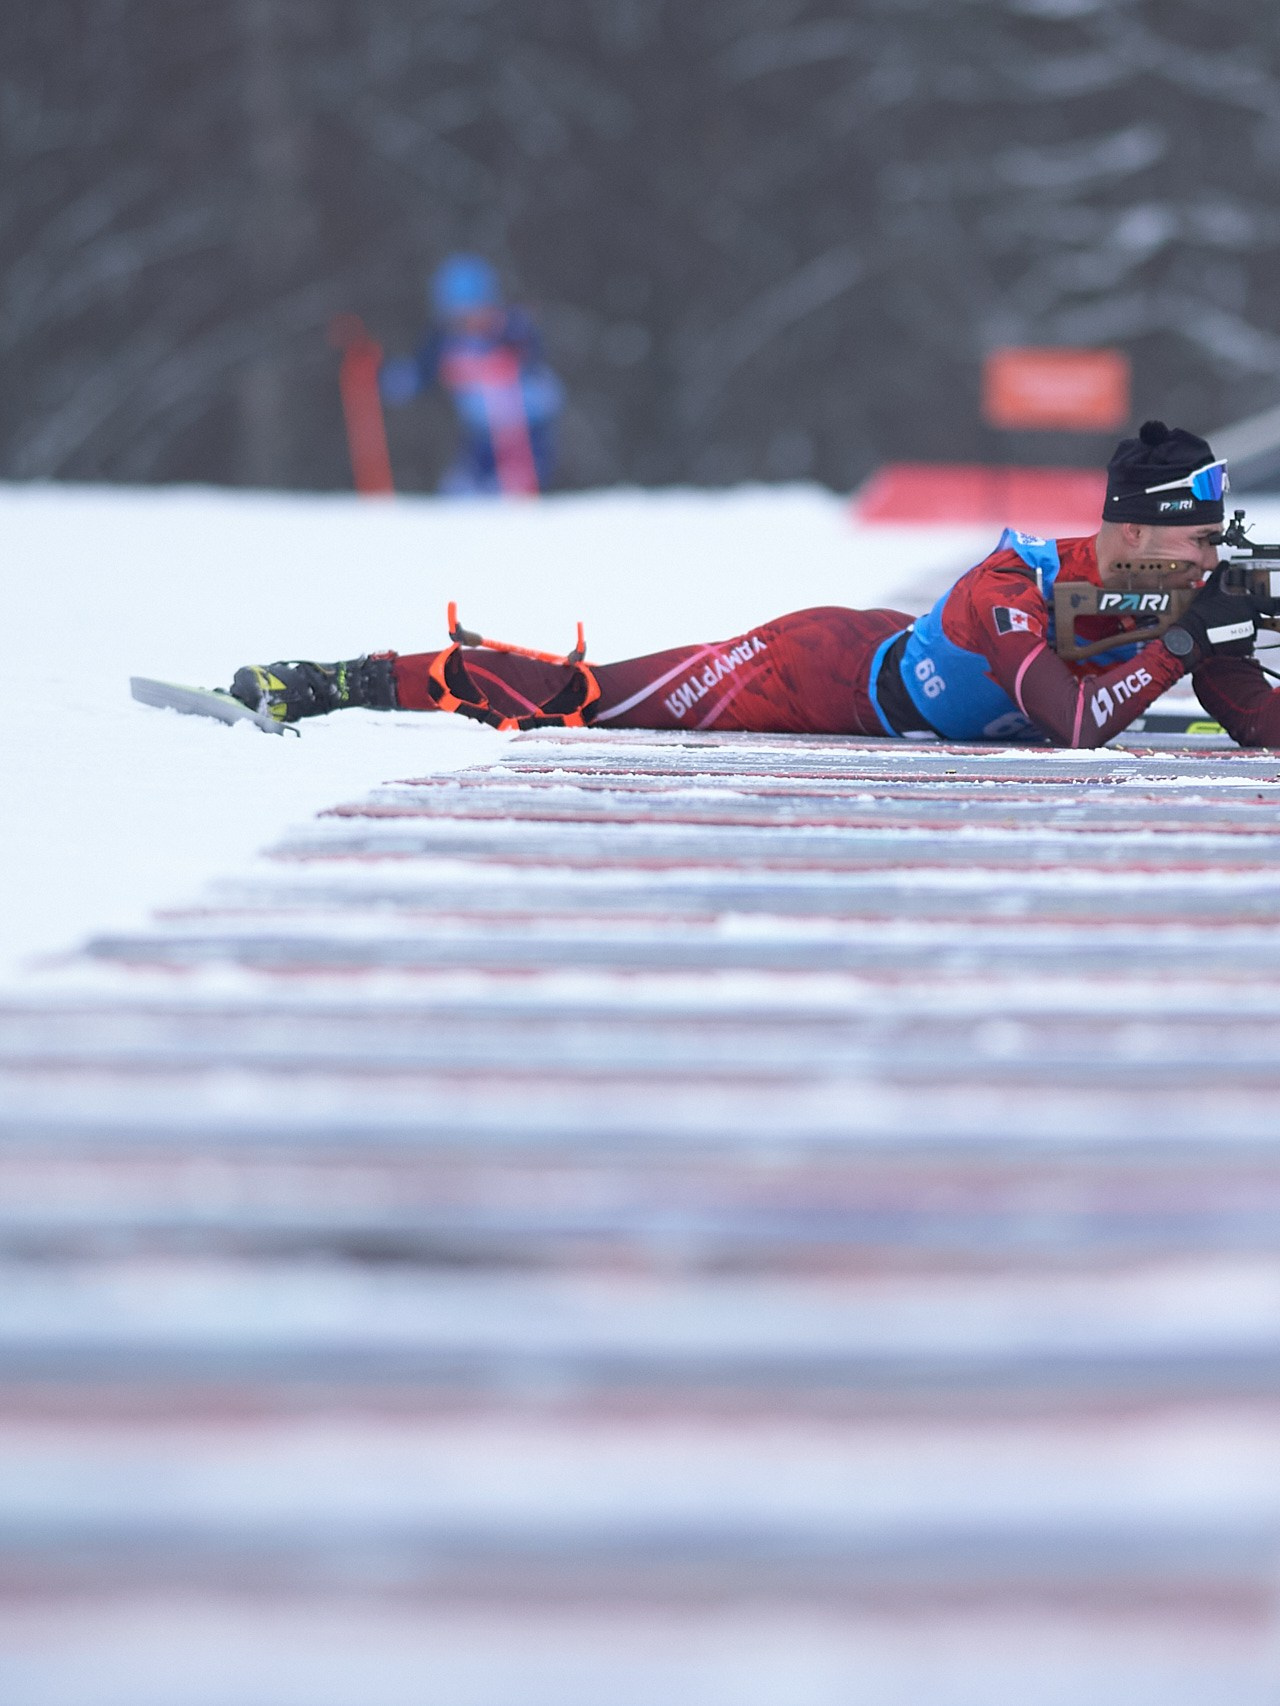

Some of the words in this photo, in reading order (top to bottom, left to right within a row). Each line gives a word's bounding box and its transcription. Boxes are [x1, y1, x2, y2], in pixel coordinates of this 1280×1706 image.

[1159, 499, 1194, 512] PARI
[1099, 593, 1170, 611] PARI
[663, 636, 768, 719] УДМУРТИЯ
[1112, 667, 1153, 704] ПСБ
